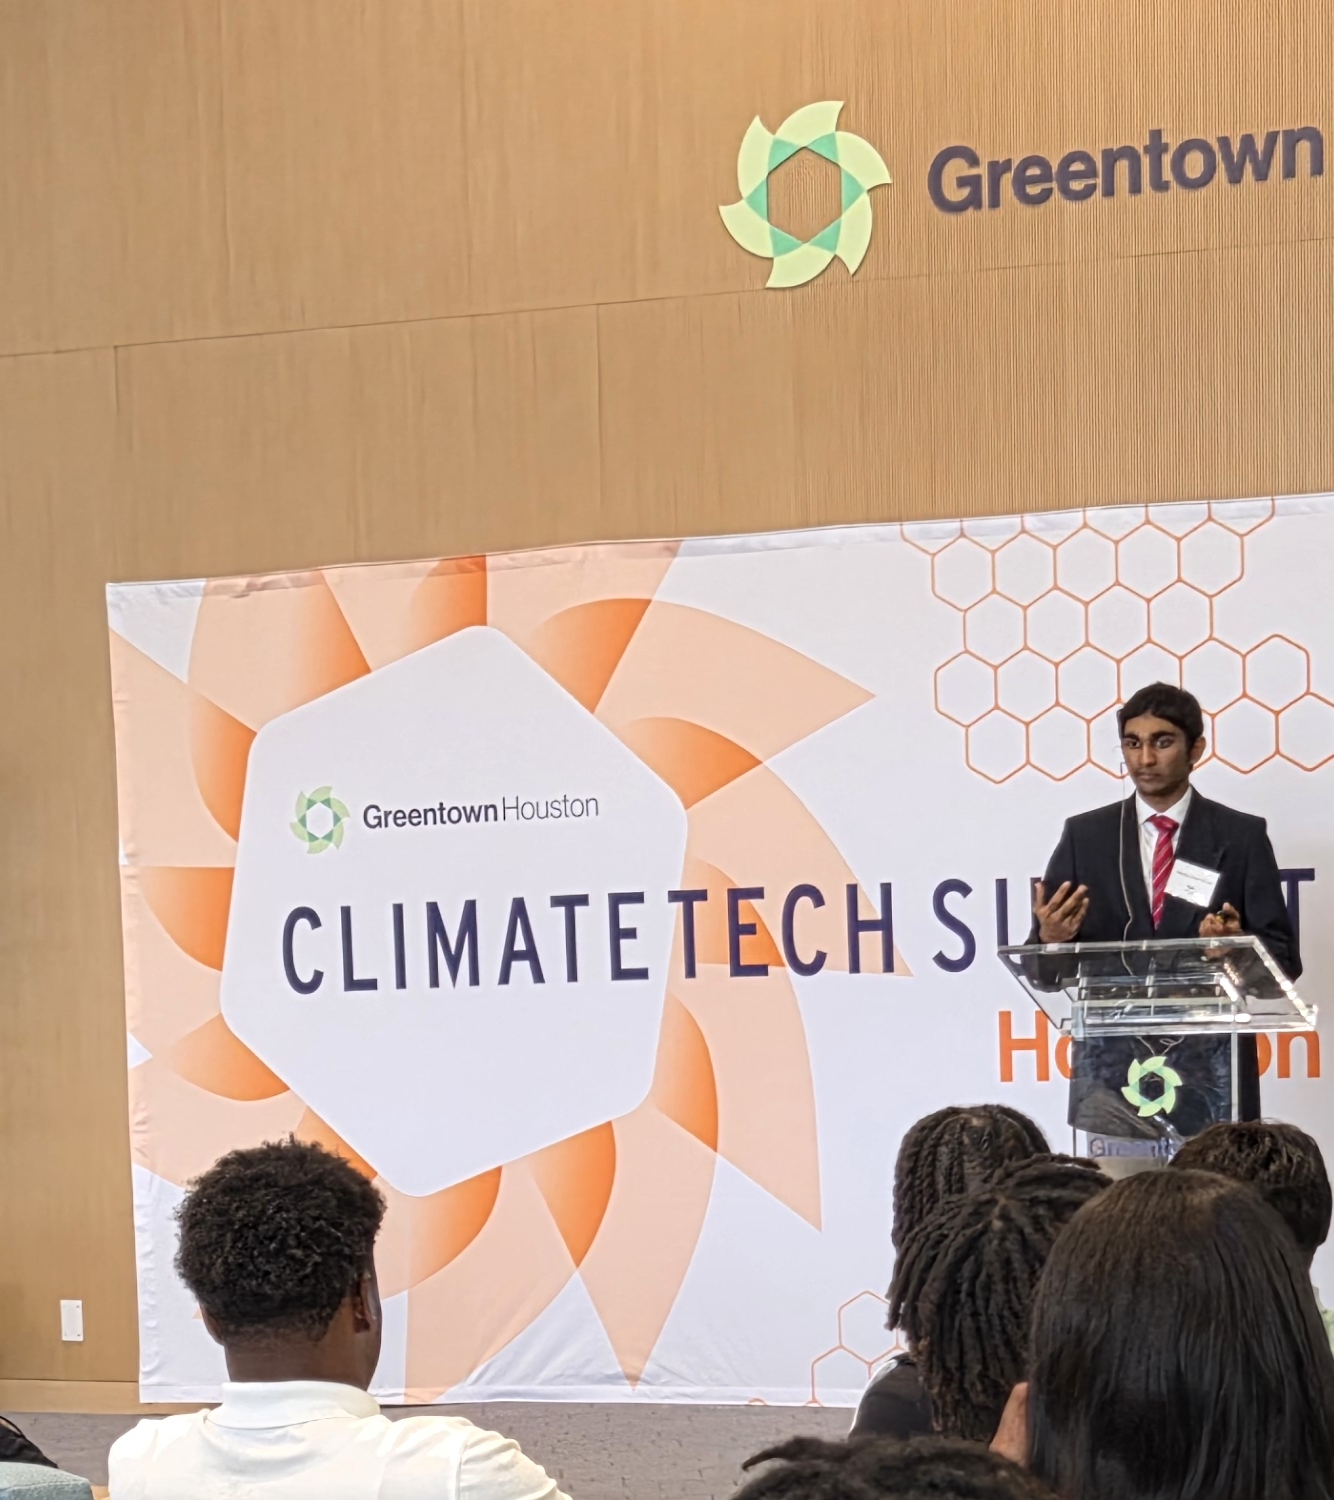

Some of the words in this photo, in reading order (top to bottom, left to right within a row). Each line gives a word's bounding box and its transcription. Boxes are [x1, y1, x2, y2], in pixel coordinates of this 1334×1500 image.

[928, 126, 1324, 214] Greentown
[363, 802, 499, 829] Greentown
[502, 794, 599, 822] Houston
